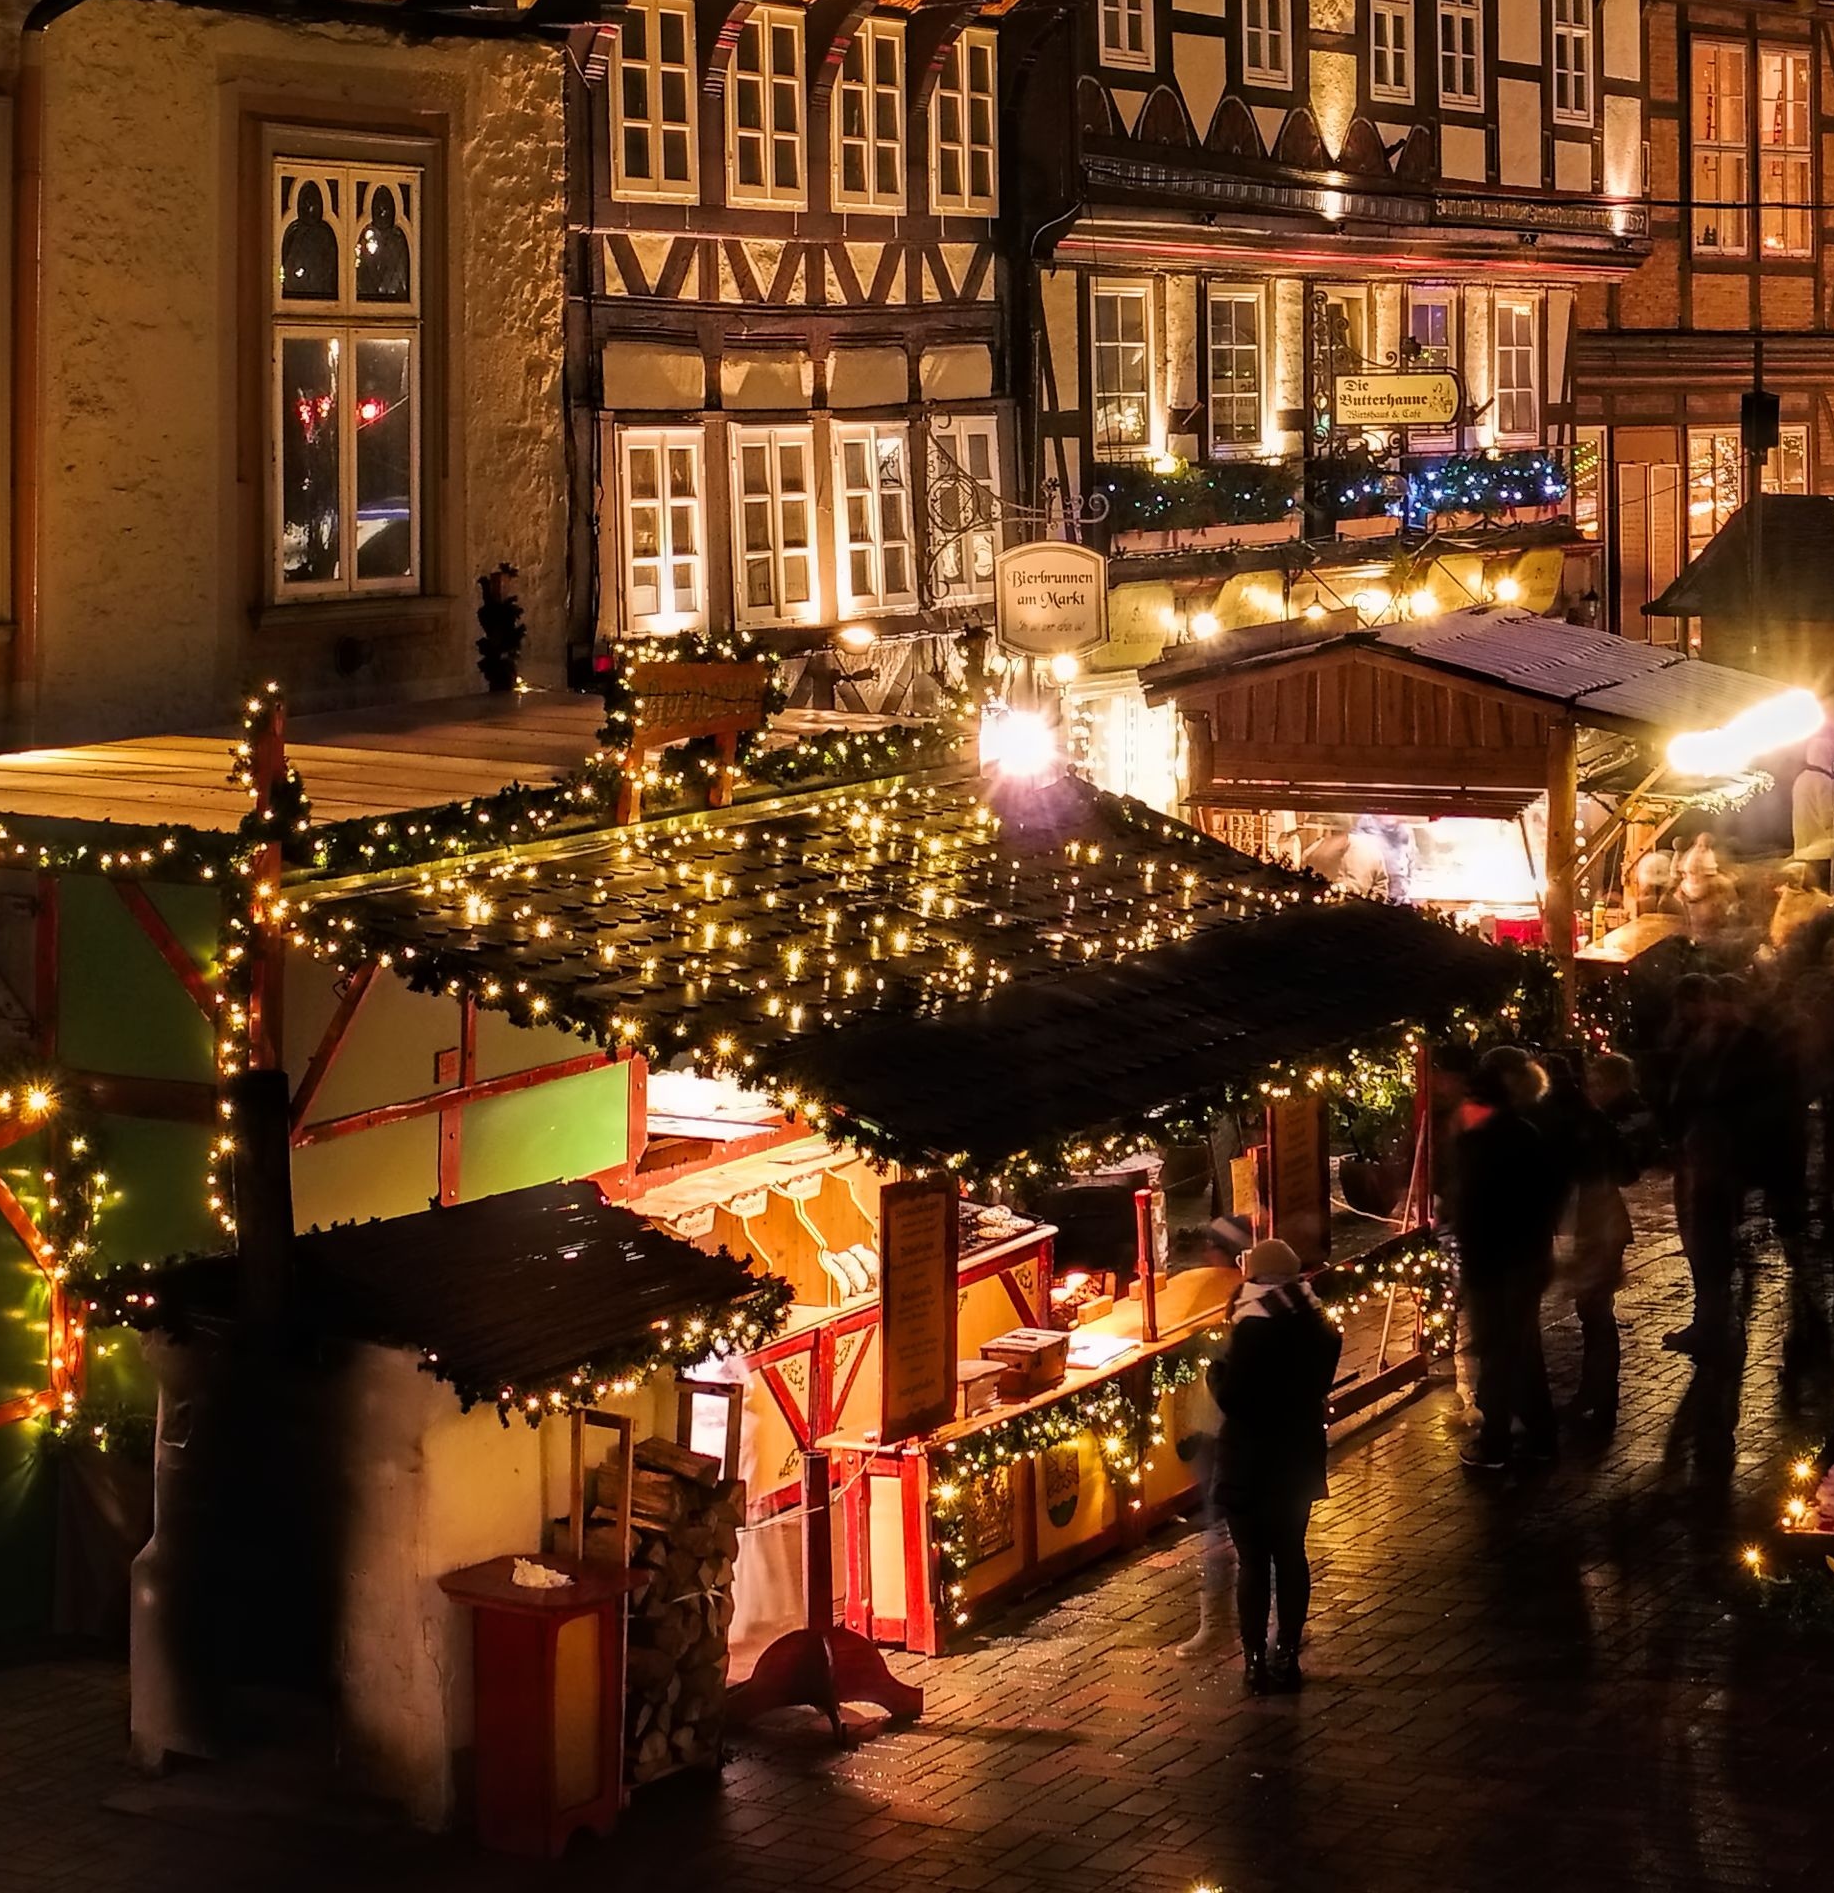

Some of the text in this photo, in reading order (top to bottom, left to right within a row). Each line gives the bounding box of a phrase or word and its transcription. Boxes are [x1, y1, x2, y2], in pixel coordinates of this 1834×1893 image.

[1344, 379, 1369, 392] Die
[1339, 393, 1428, 408] Butterhanne
[1007, 570, 1093, 588] Bierbrunnen
[1017, 591, 1085, 609] am Markt
